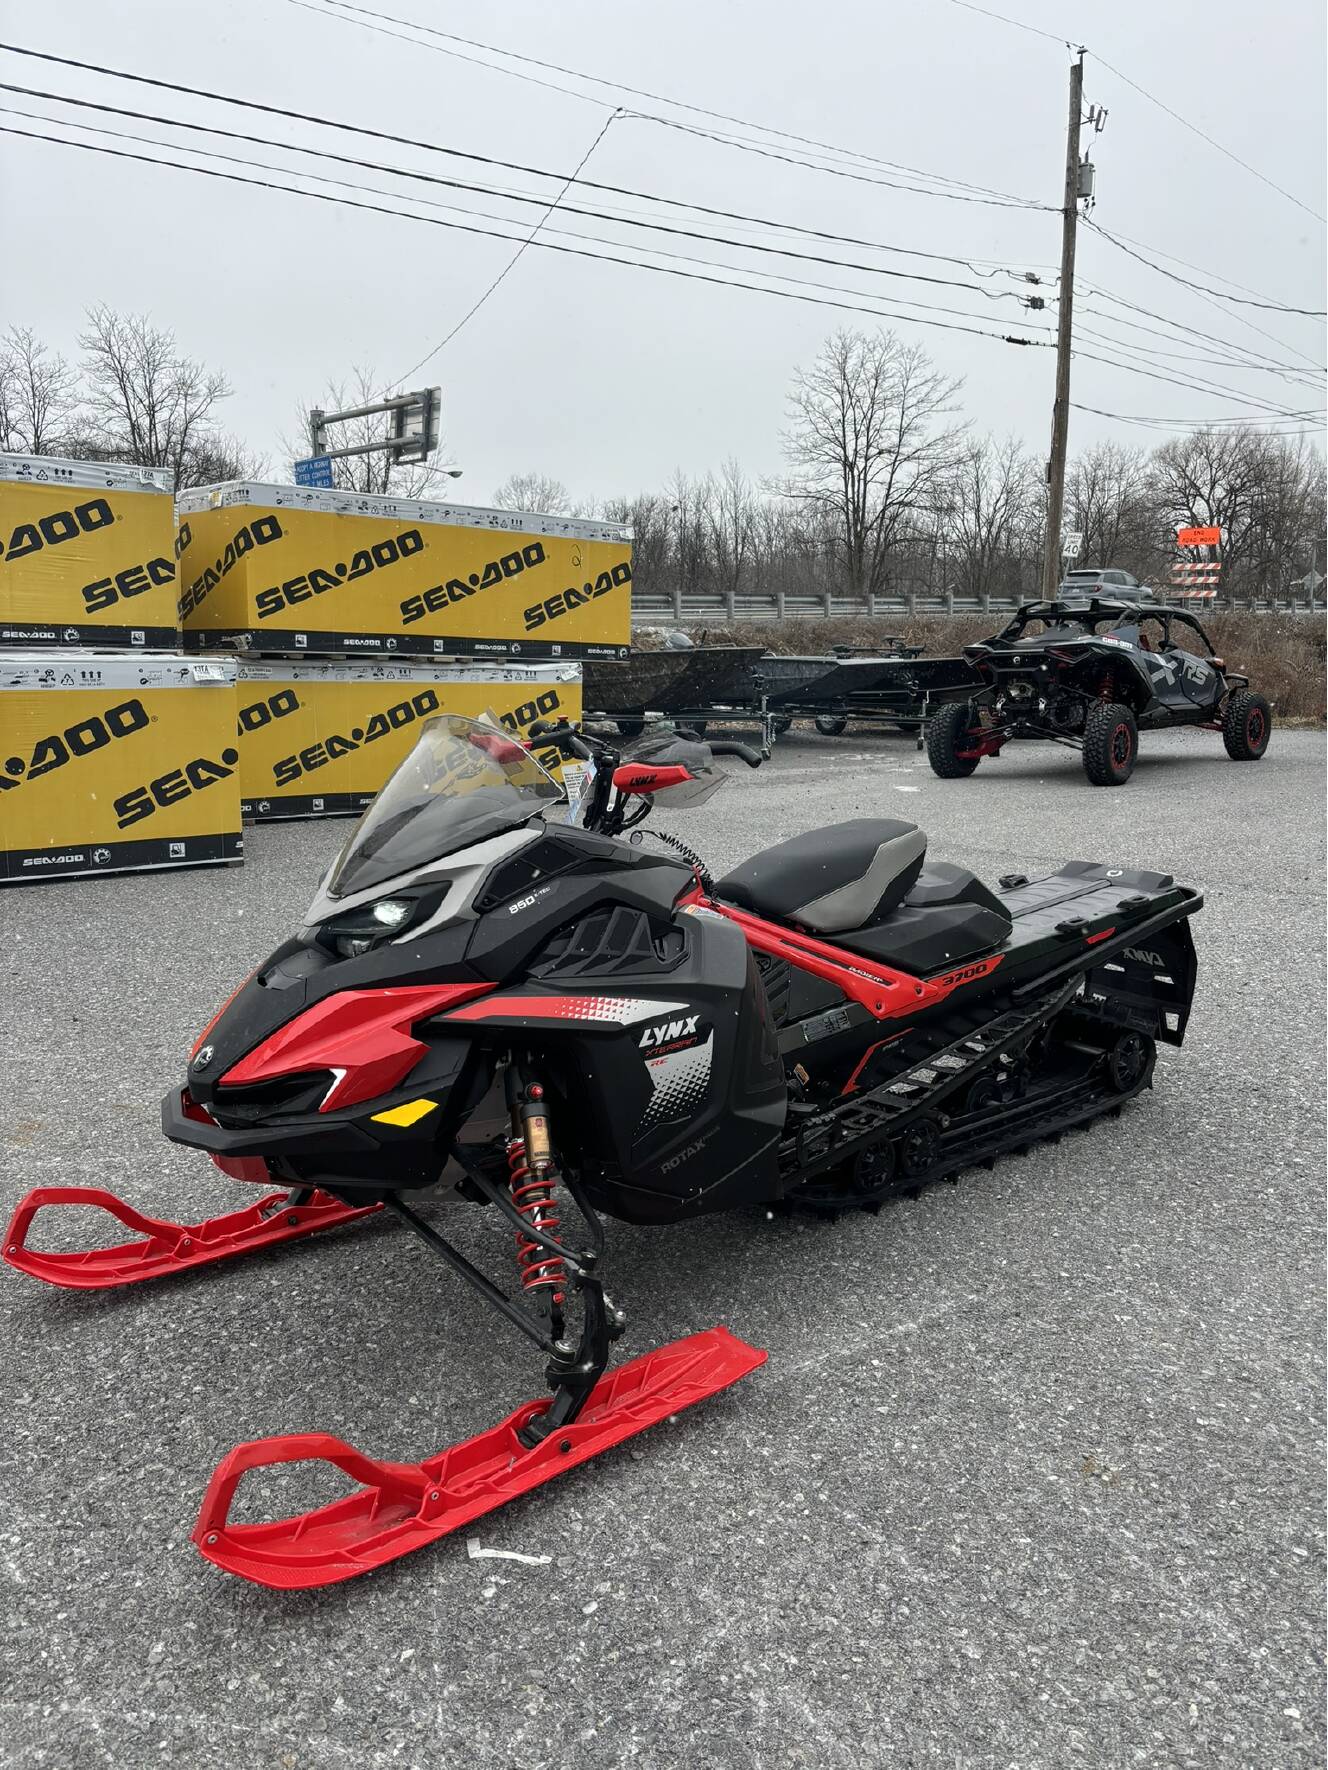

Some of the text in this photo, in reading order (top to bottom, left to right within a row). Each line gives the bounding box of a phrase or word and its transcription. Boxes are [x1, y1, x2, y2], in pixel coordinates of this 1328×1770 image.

[1064, 544, 1079, 554] 40
[509, 895, 535, 914] 850
[942, 964, 988, 987] 3700
[639, 1015, 701, 1048] LYNX
[660, 1138, 706, 1174] ROTAX
